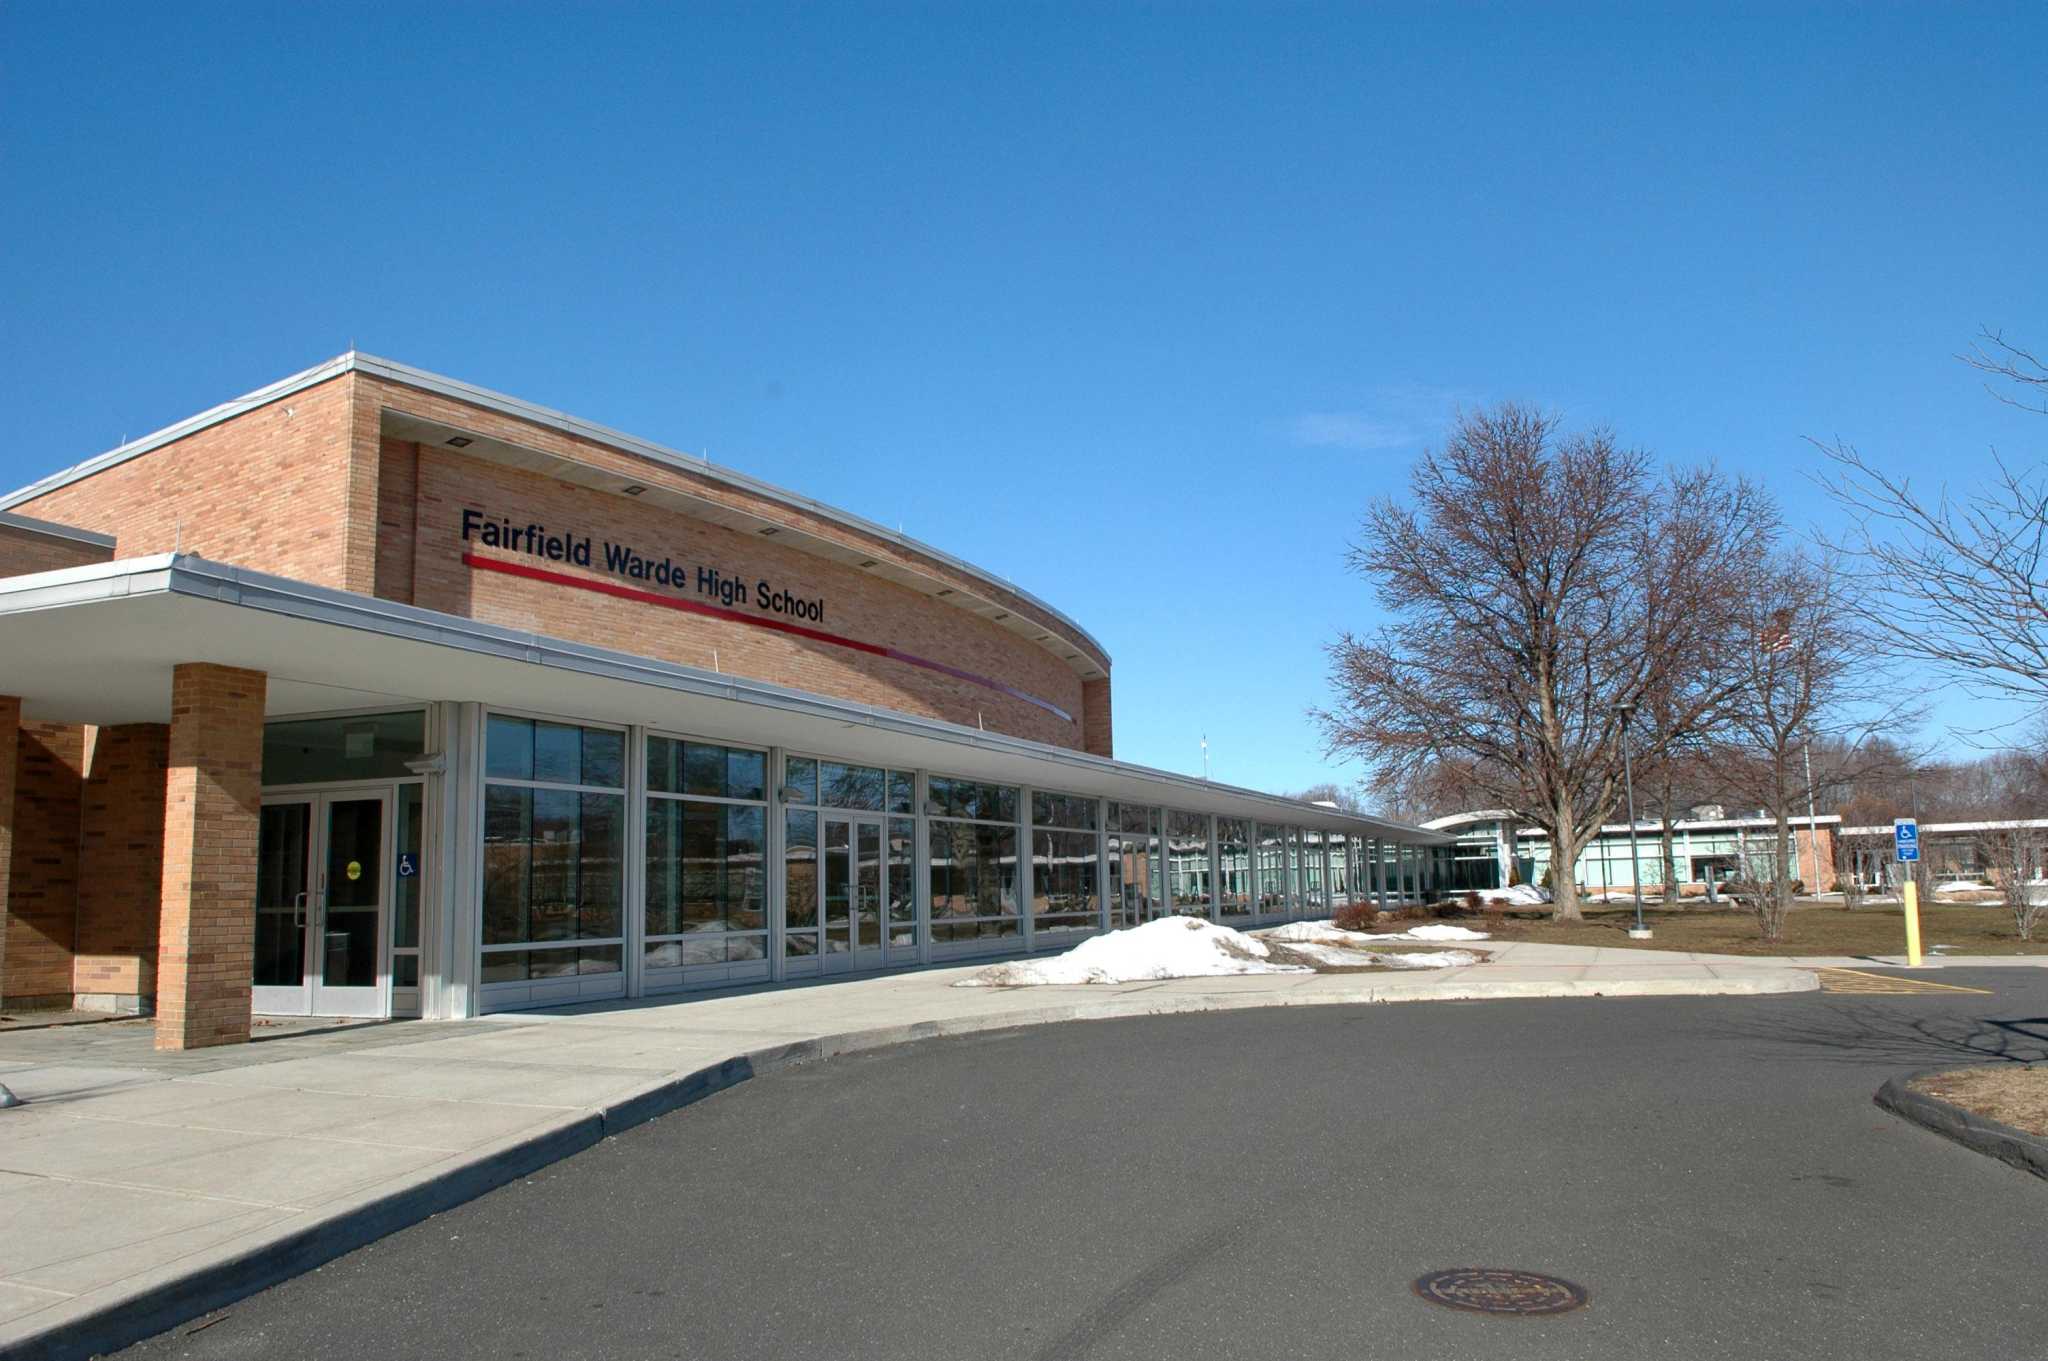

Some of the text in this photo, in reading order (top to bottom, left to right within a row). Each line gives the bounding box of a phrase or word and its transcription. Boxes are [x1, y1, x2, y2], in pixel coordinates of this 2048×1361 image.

[462, 509, 823, 623] Fairfield Warde High School
